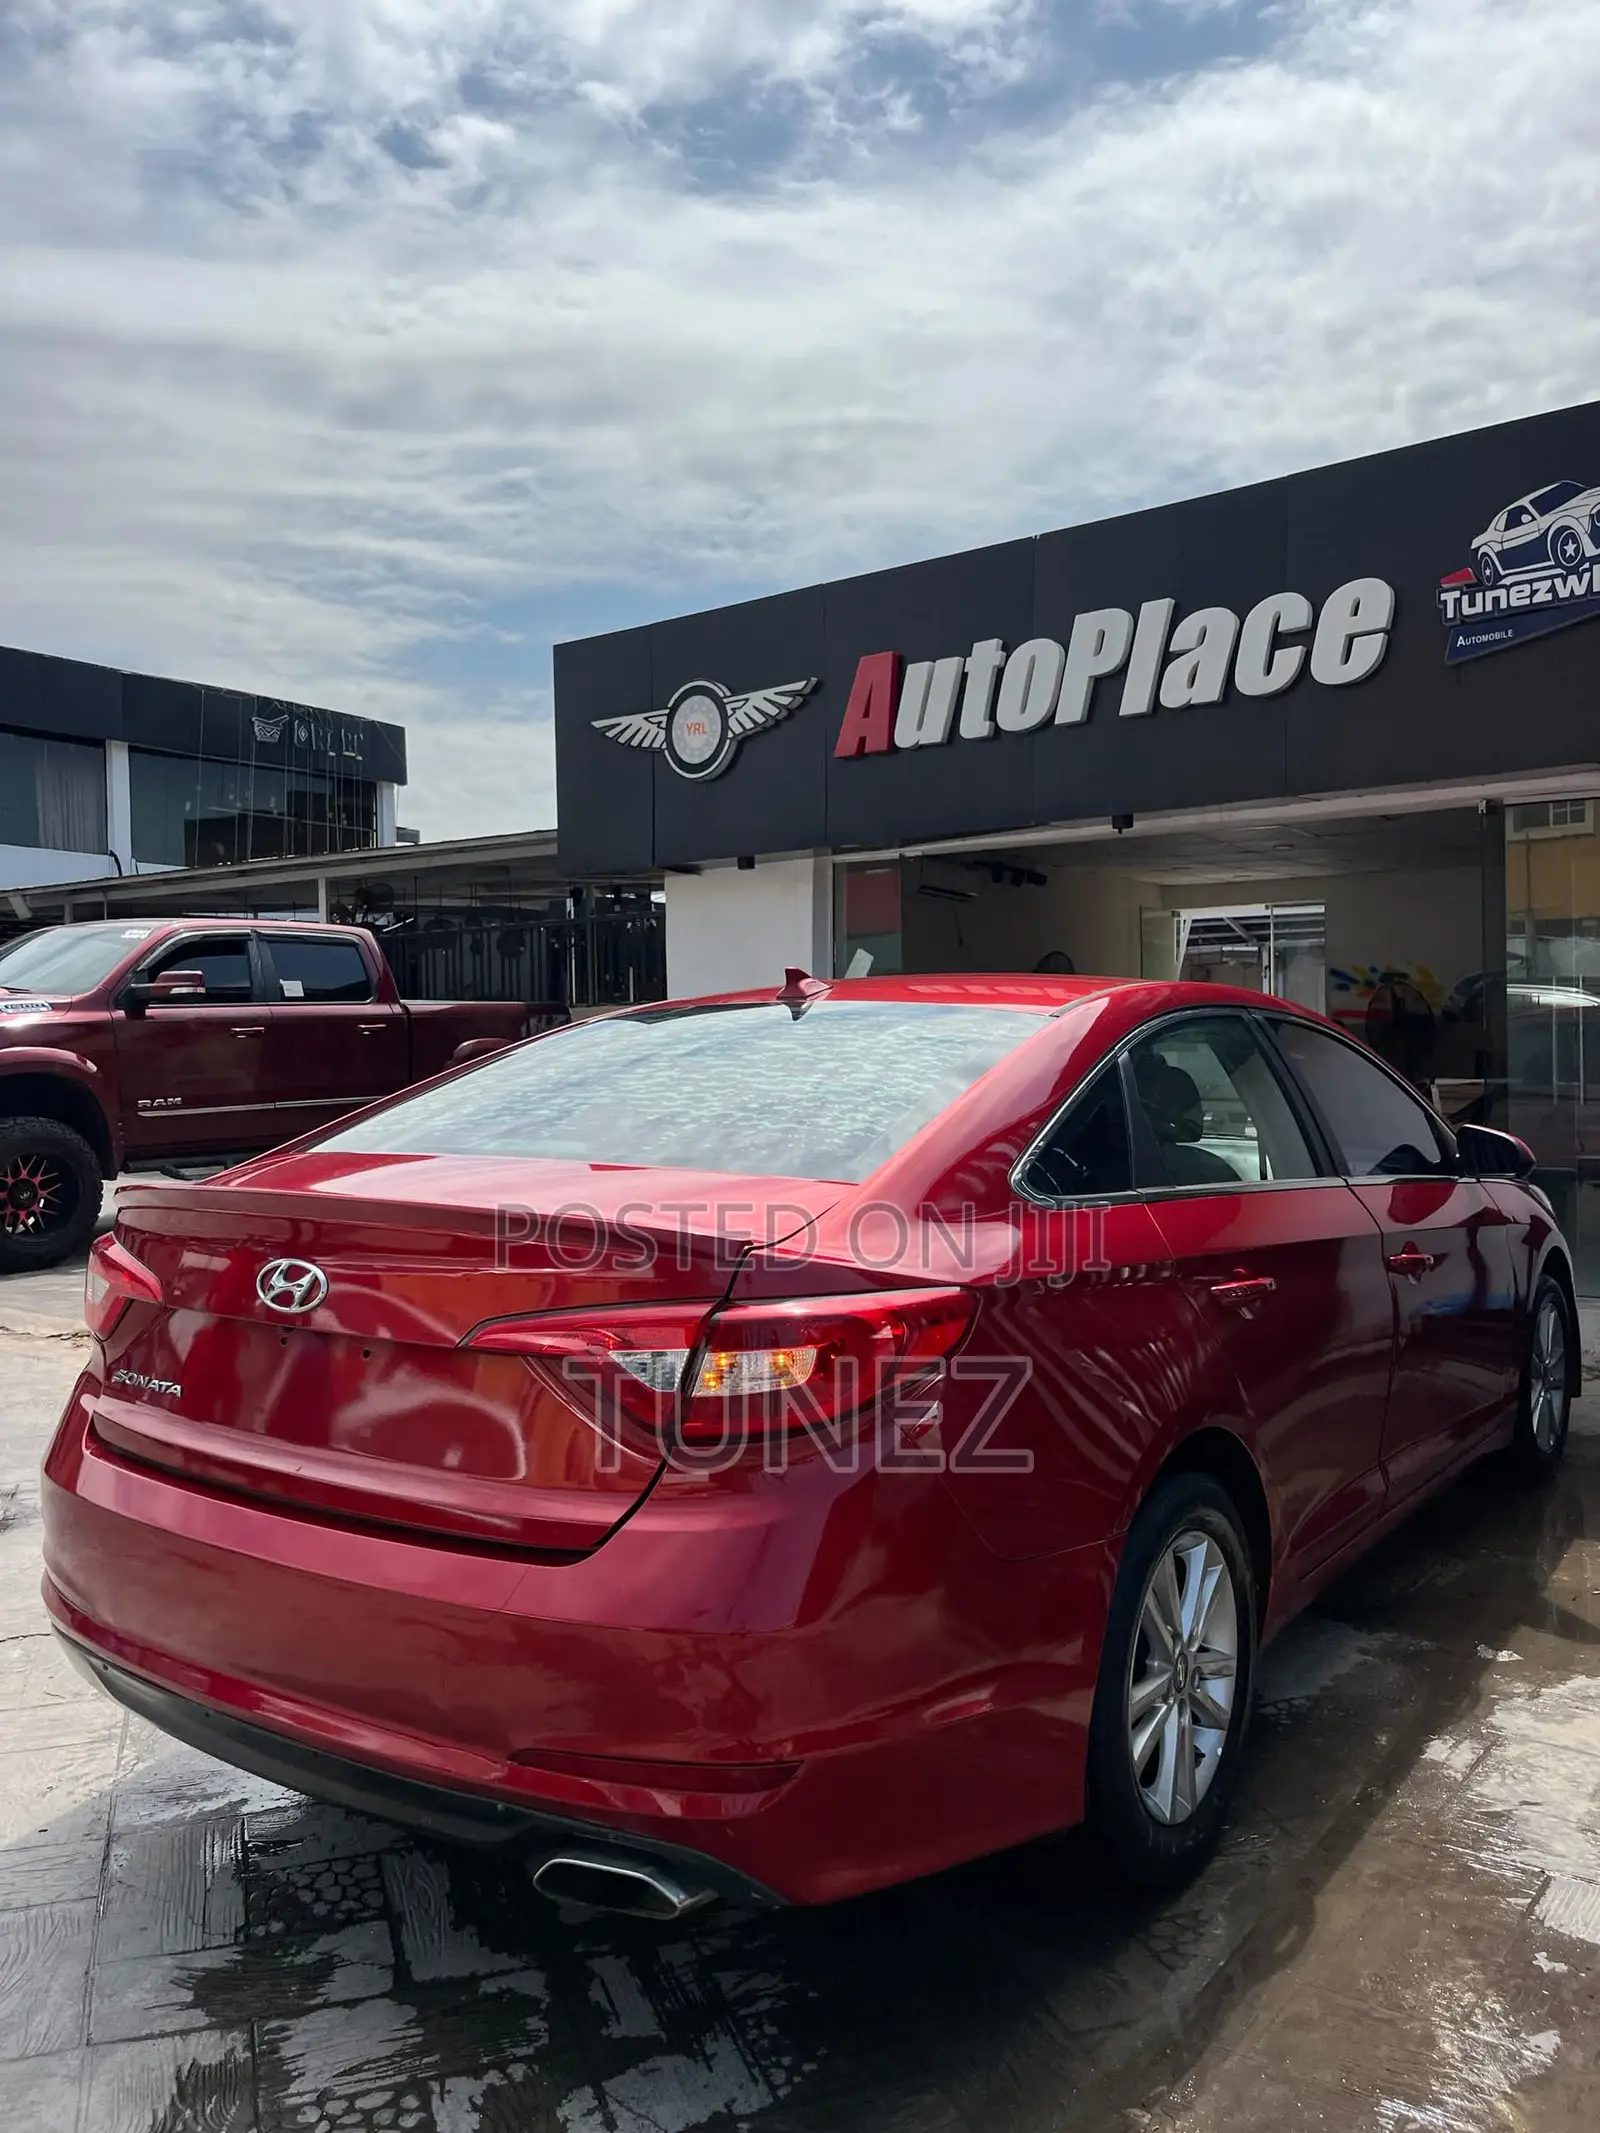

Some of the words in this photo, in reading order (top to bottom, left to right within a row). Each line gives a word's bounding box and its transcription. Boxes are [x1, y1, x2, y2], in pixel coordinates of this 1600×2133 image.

[833, 577, 1395, 758] AutoPlace
[686, 721, 708, 736] YRL
[137, 1097, 182, 1108] RAM
[111, 1368, 182, 1398] SONATA
